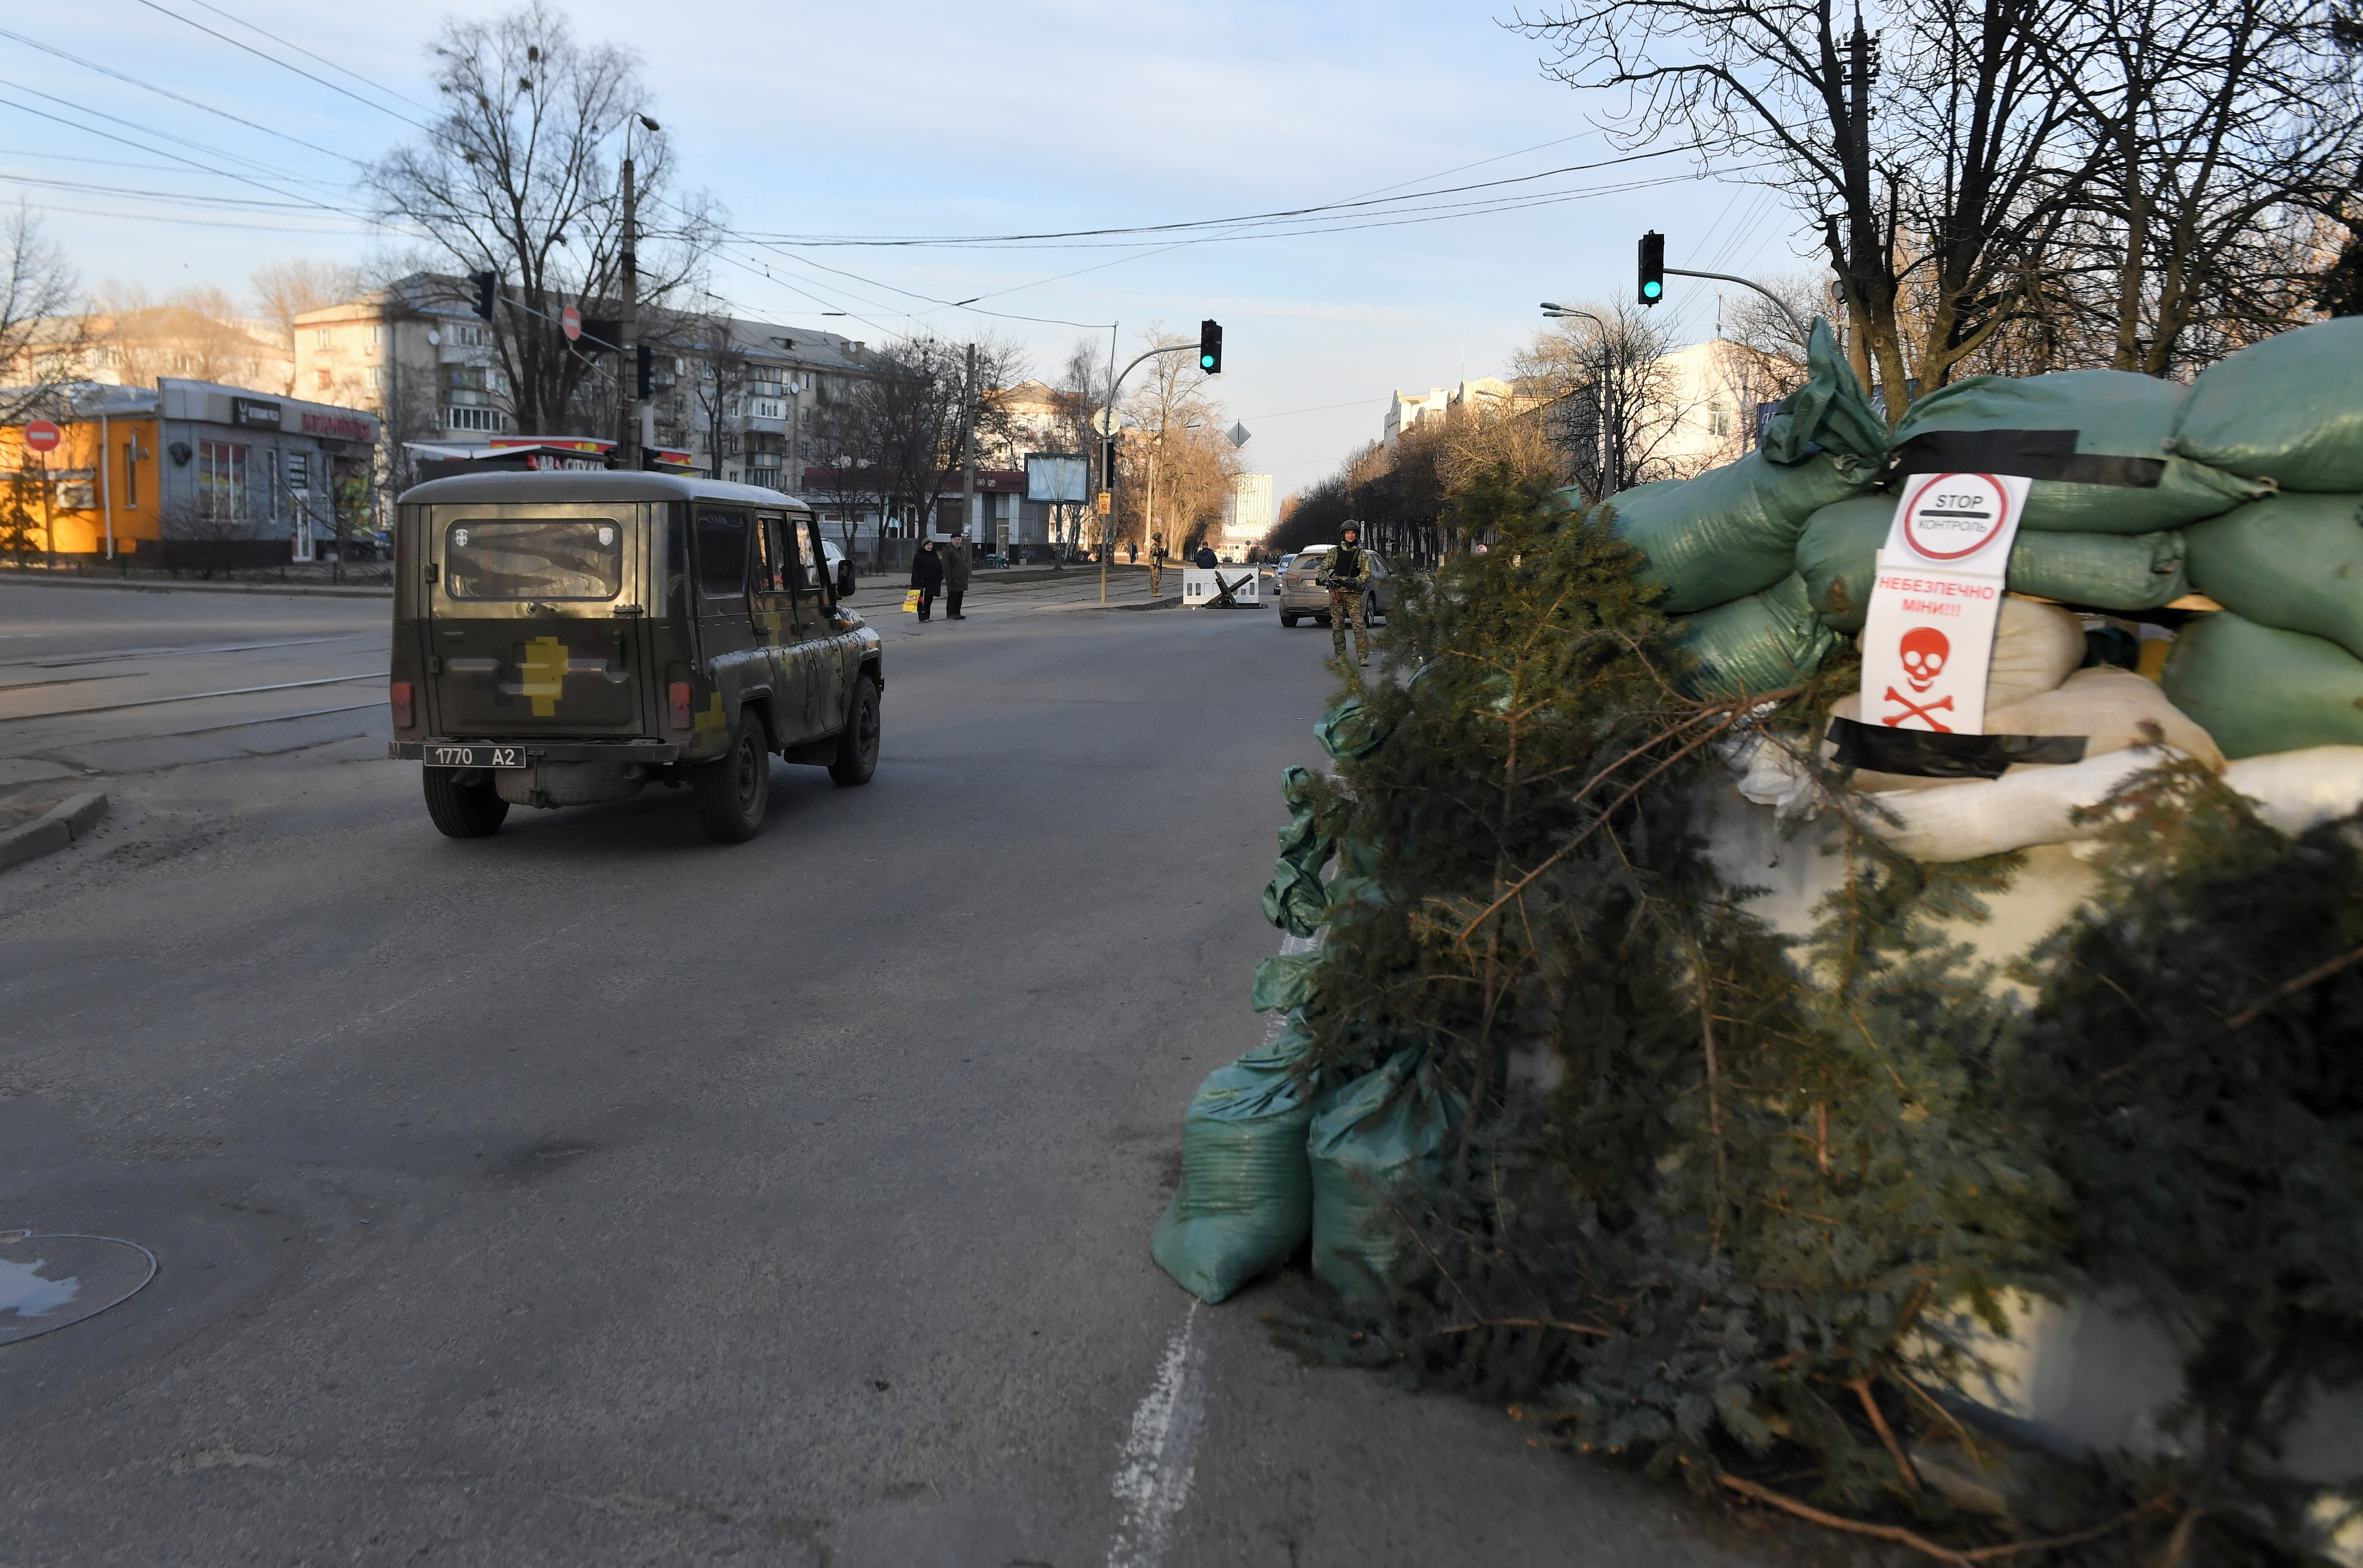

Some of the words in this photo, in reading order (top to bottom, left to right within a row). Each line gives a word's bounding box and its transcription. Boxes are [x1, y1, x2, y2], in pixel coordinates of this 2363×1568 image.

[1936, 495, 1983, 509] STOP
[1918, 520, 1987, 532] КОНТРОЛЬ
[1879, 577, 1995, 599] НЕБЕЗПЕЧНО
[1902, 598, 1962, 617] МІНИ!!!
[435, 748, 473, 765] 1770
[492, 749, 515, 765] A2
